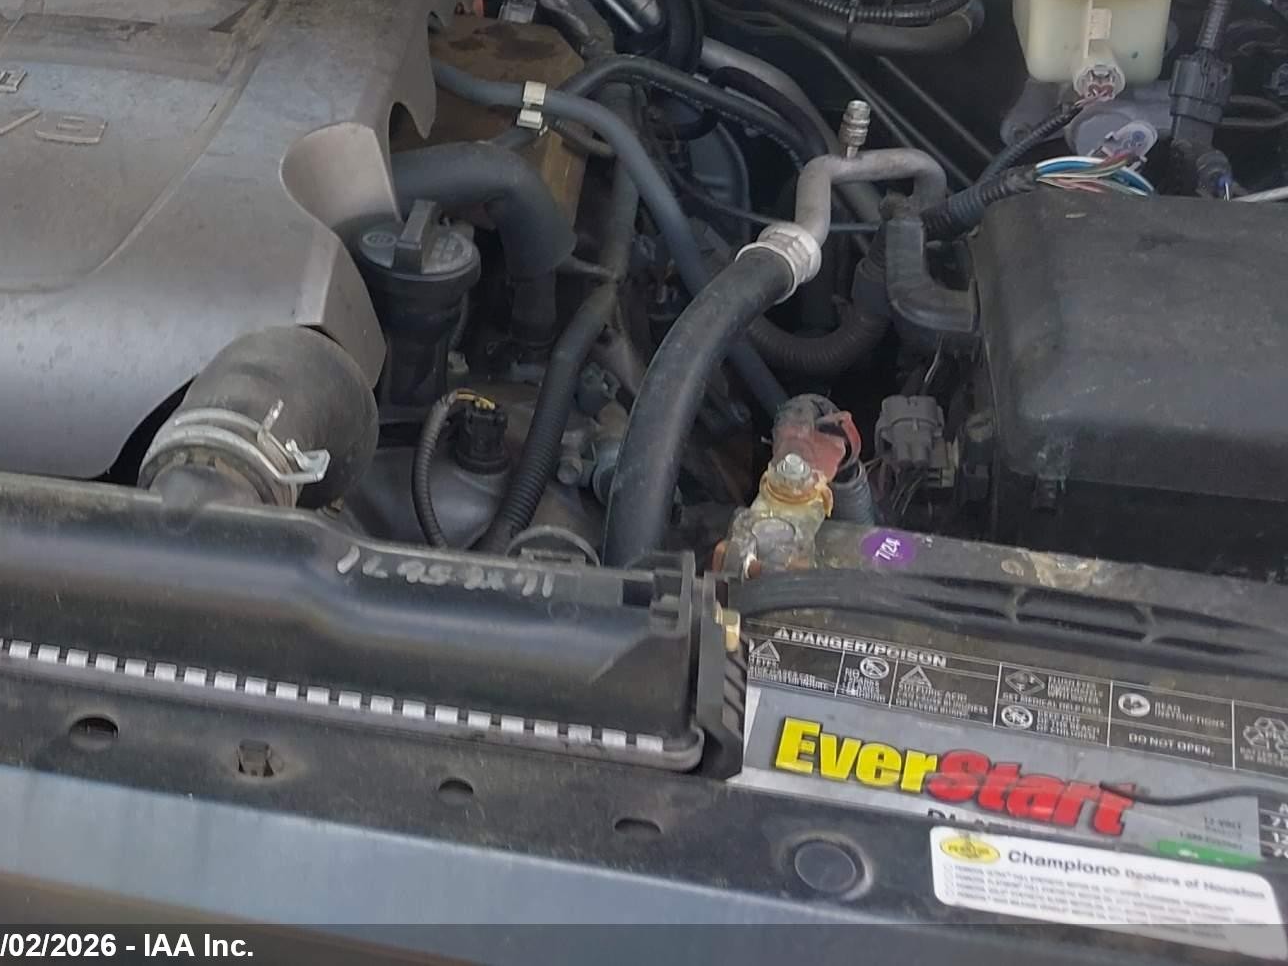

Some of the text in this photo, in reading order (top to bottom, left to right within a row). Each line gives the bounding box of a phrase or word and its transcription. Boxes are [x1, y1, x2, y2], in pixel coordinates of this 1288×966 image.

[791, 630, 947, 667] DANGER/POISON
[1128, 732, 1147, 745] DO
[1149, 735, 1174, 749] NOT
[774, 716, 1134, 835] EverStart
[1124, 867, 1180, 886] Dealers
[1185, 879, 1200, 889] of
